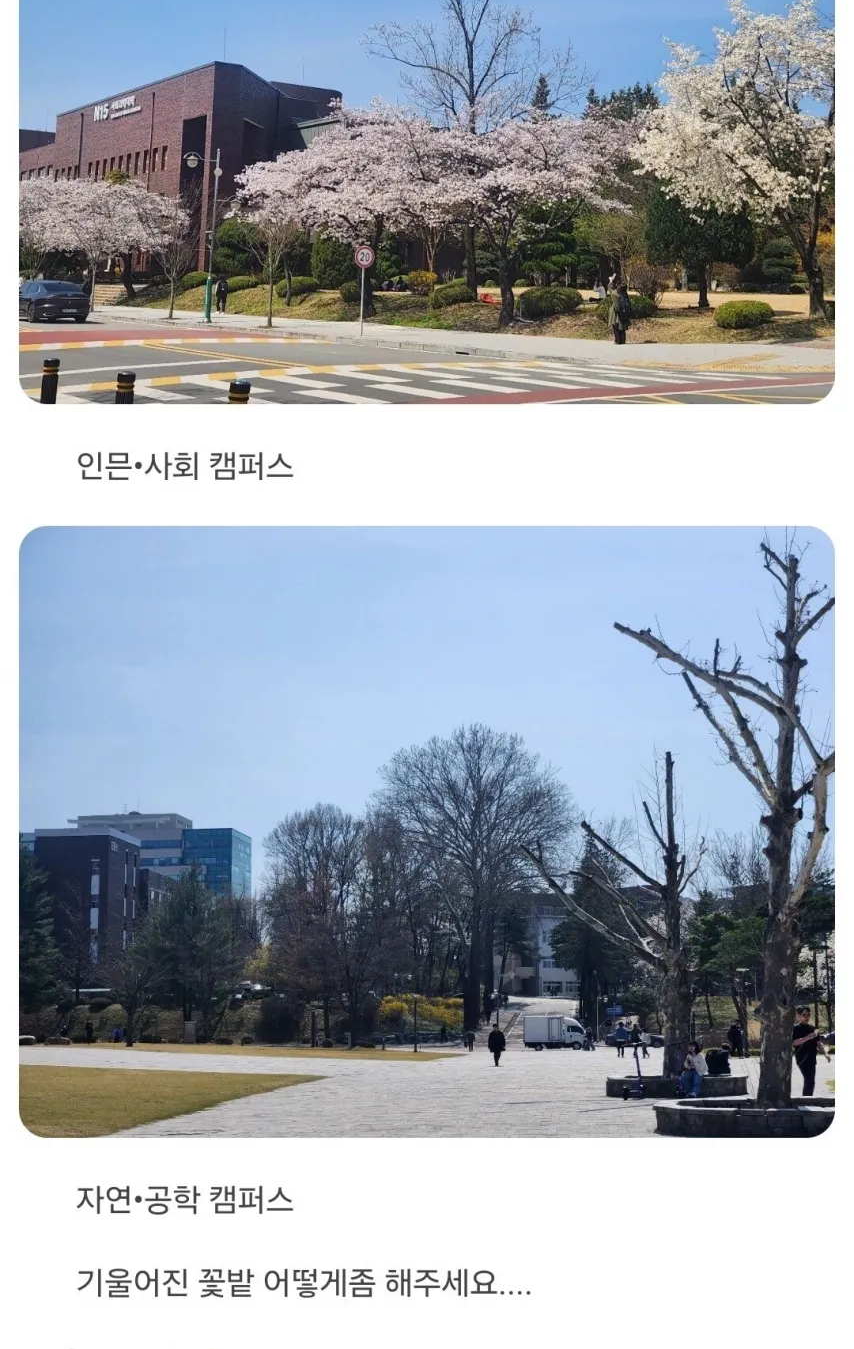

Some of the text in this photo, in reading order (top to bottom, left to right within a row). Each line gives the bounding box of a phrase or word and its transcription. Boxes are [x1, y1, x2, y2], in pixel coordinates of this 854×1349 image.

[359, 252, 370, 262] 20
[210, 452, 294, 480] 캠퍼스
[210, 1186, 294, 1214] 캠퍼스
[77, 1268, 188, 1298] 기울어진
[198, 1269, 255, 1298] 꽃밭
[265, 1269, 376, 1298] 어떻게좀
